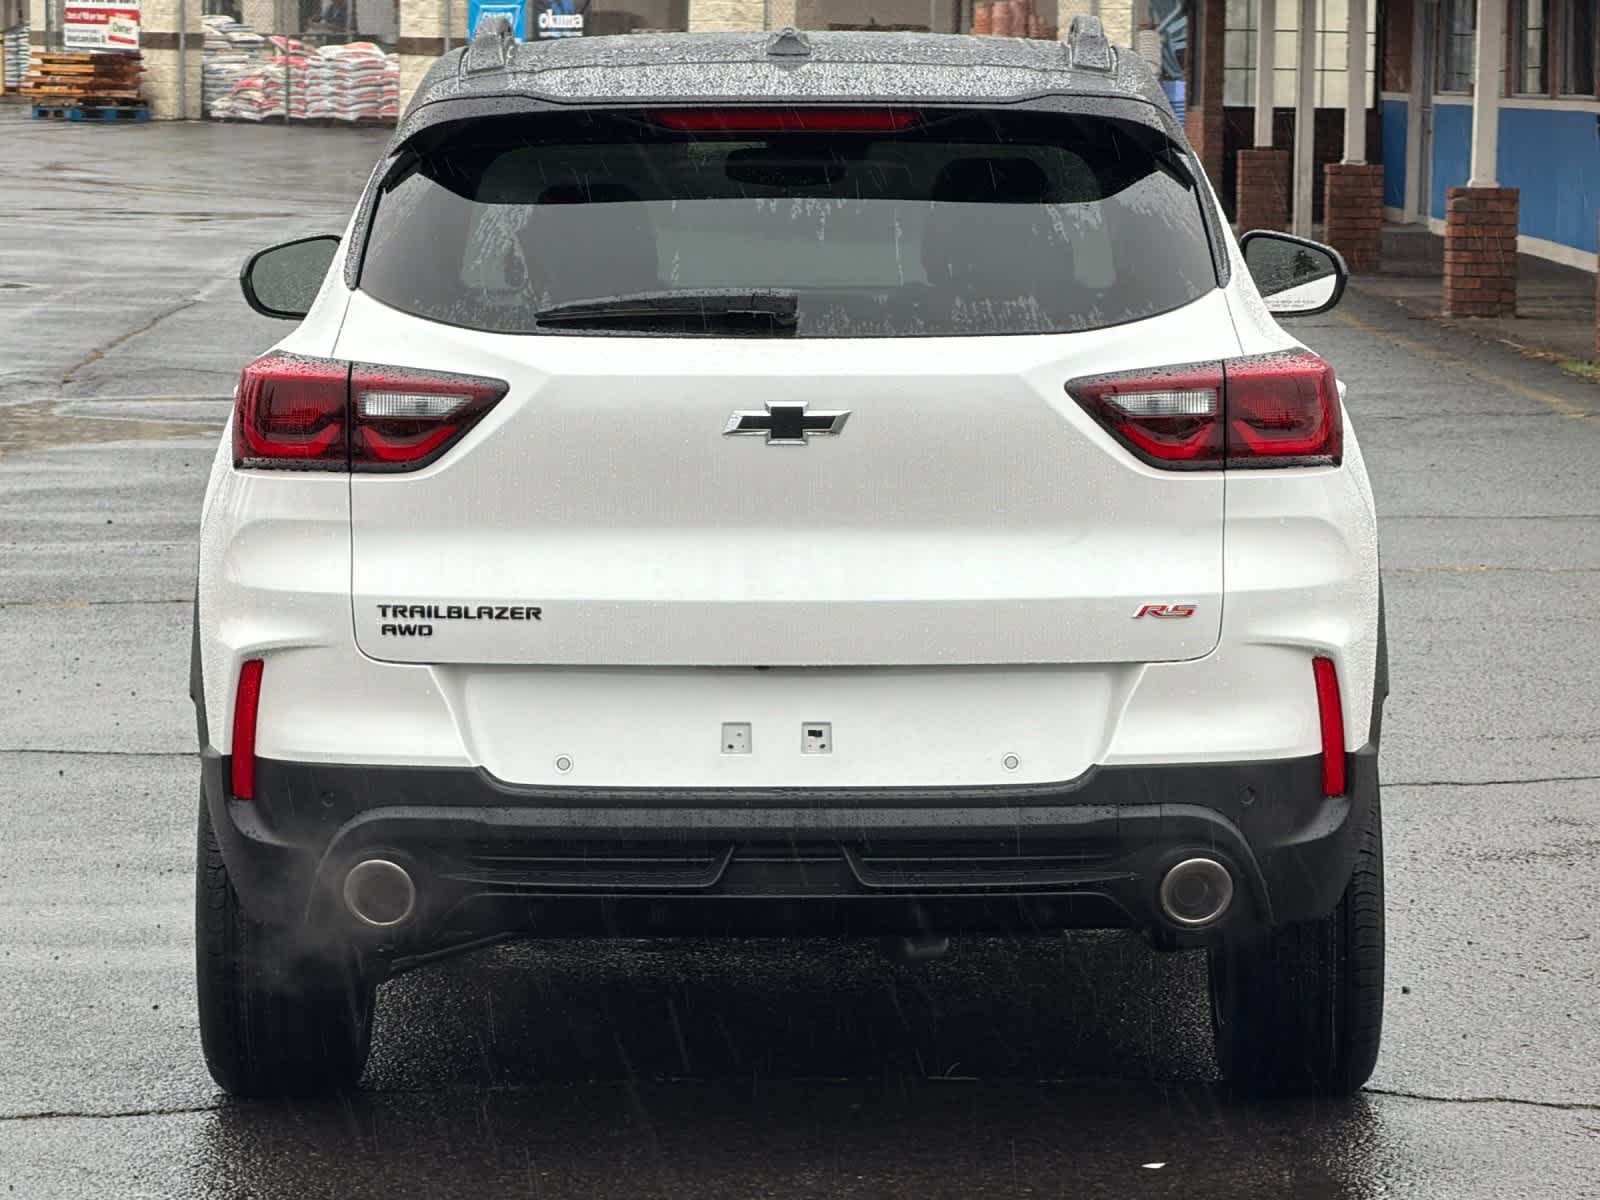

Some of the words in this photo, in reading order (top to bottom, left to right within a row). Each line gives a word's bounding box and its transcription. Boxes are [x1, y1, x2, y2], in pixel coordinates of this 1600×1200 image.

[539, 9, 584, 29] okuma
[377, 604, 543, 621] TRAILBLAZER
[1132, 603, 1200, 619] RS
[381, 623, 433, 637] AWD
